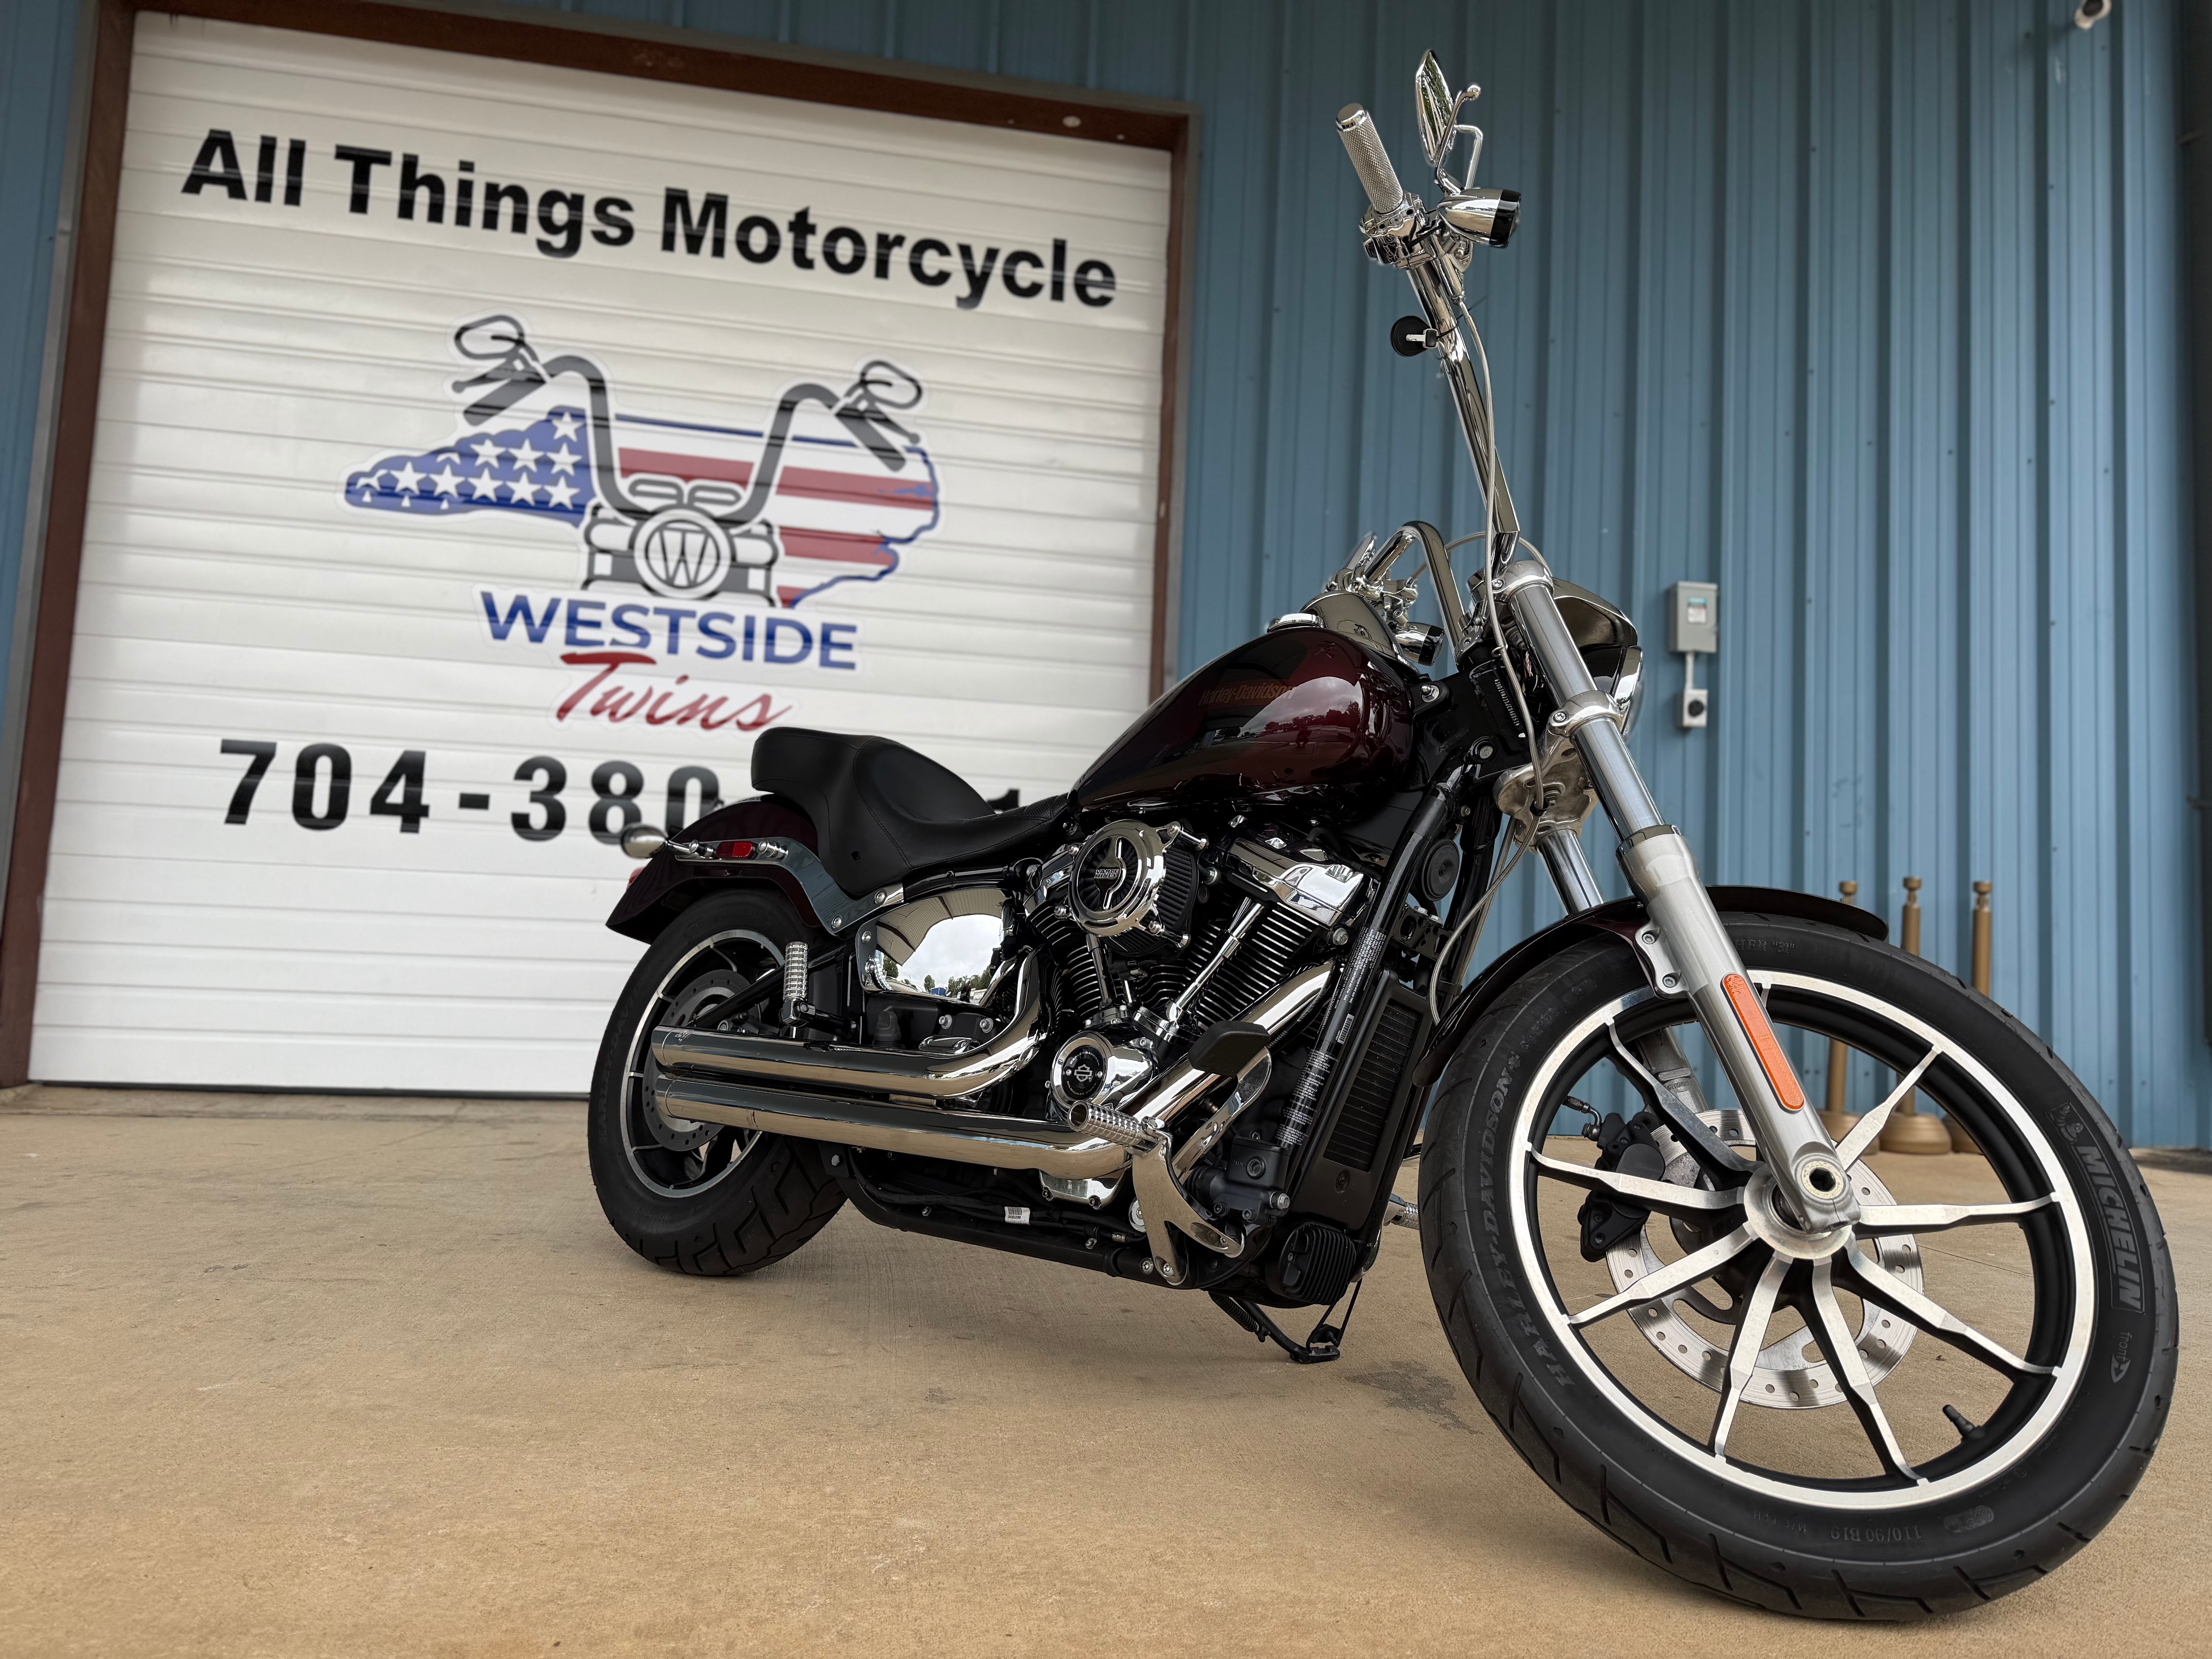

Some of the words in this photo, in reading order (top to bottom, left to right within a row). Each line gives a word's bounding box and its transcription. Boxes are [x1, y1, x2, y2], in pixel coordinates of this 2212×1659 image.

[180, 128, 306, 207] All
[334, 144, 635, 258] Things
[661, 187, 1116, 309] Motorcycle
[480, 592, 857, 669] WESTSIDE
[555, 651, 792, 732] Twins
[1200, 683, 1294, 705] Harley-Davidson
[1477, 1068, 1575, 1388] HARLEY-DAVIDSON
[2076, 1145, 2143, 1311] MICHELIN
[2118, 1331, 2133, 1362] front
[1830, 1523, 1861, 1542] B19
[1866, 1524, 1923, 1543] 110/90
